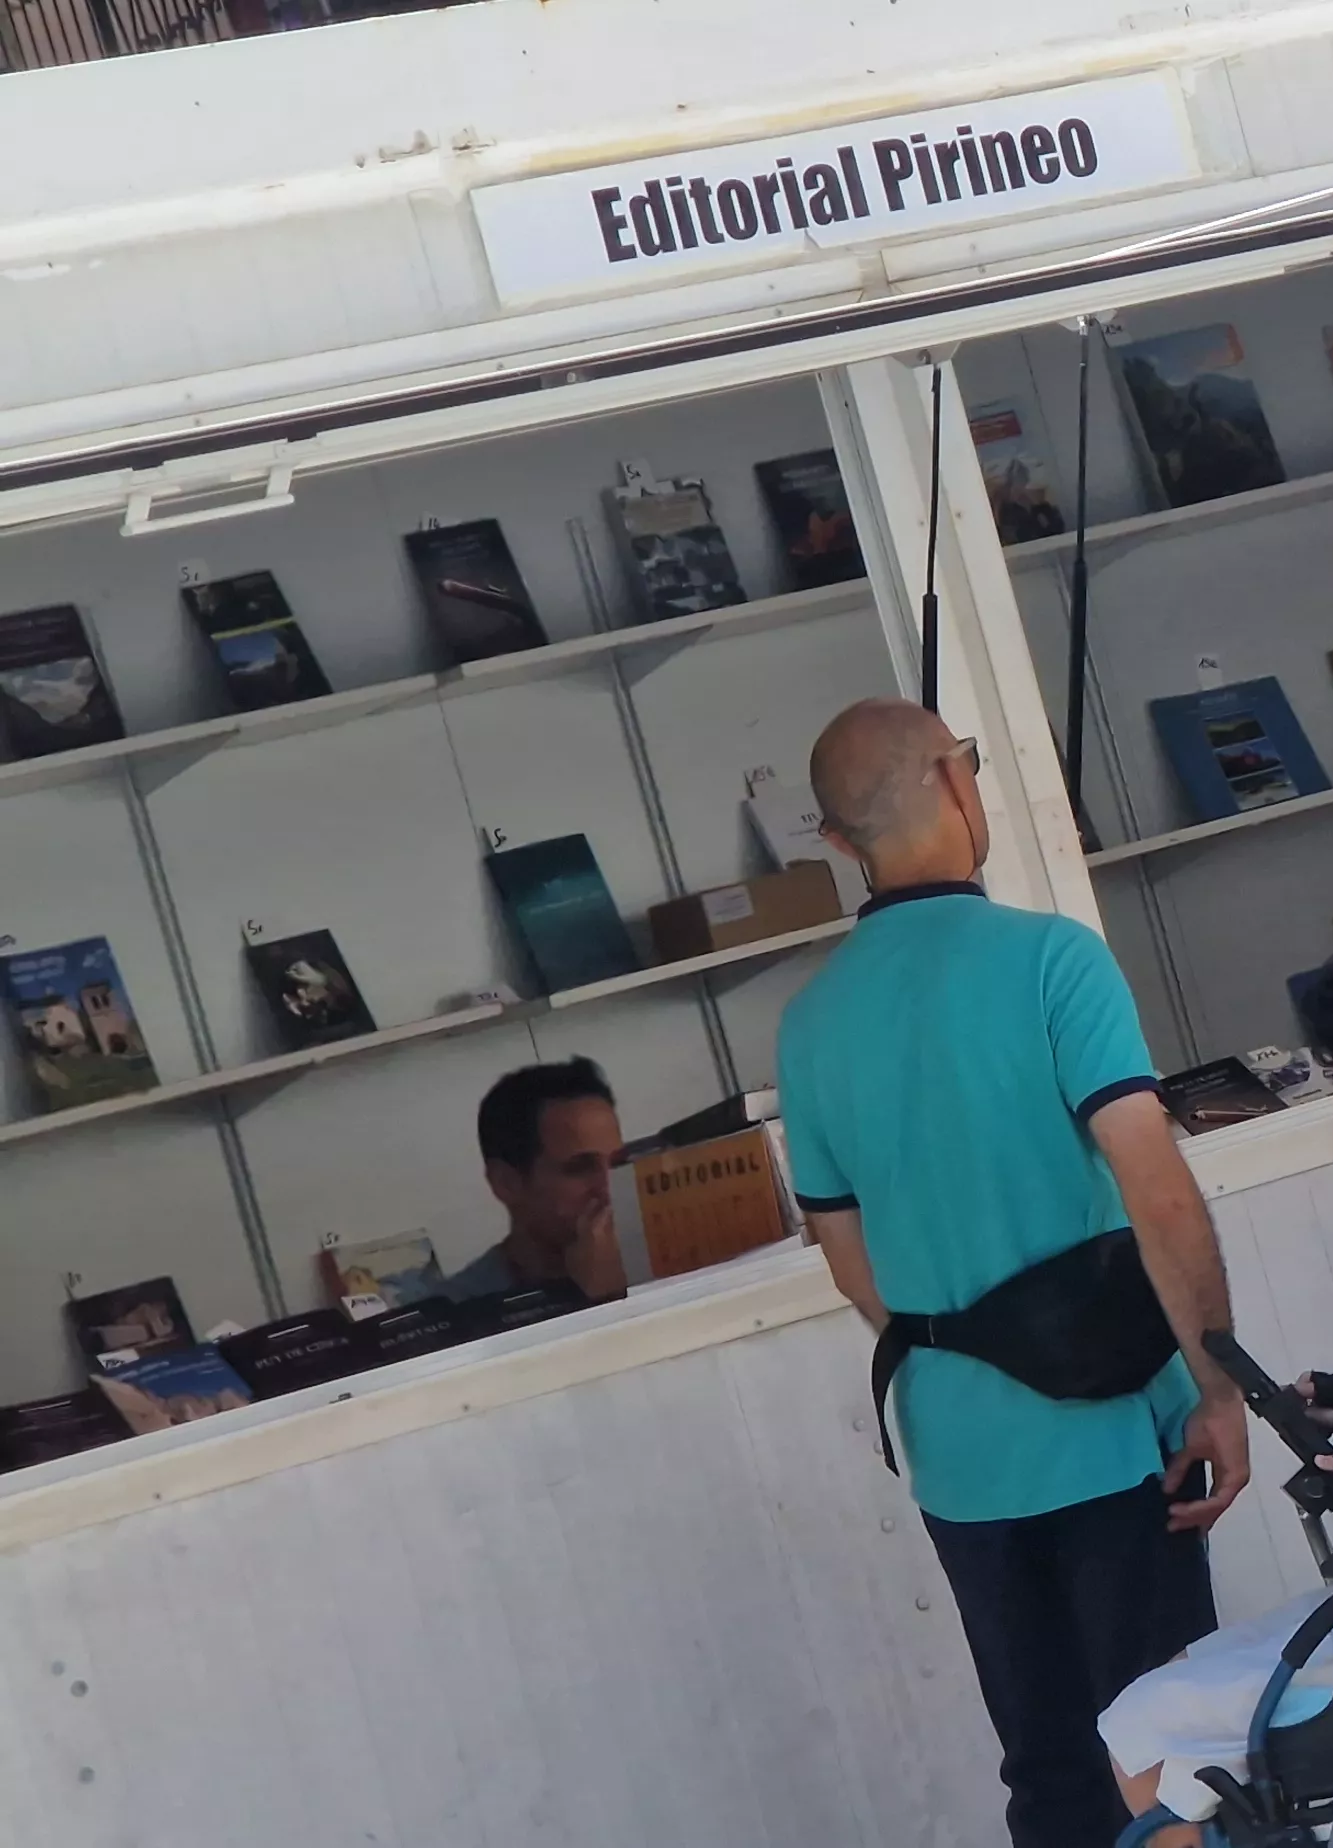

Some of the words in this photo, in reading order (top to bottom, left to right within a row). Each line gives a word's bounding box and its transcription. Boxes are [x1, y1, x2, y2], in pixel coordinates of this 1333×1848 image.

[591, 146, 870, 264] Editorial
[872, 117, 1099, 212] Pirineo
[645, 1152, 760, 1195] EDITORIAL
